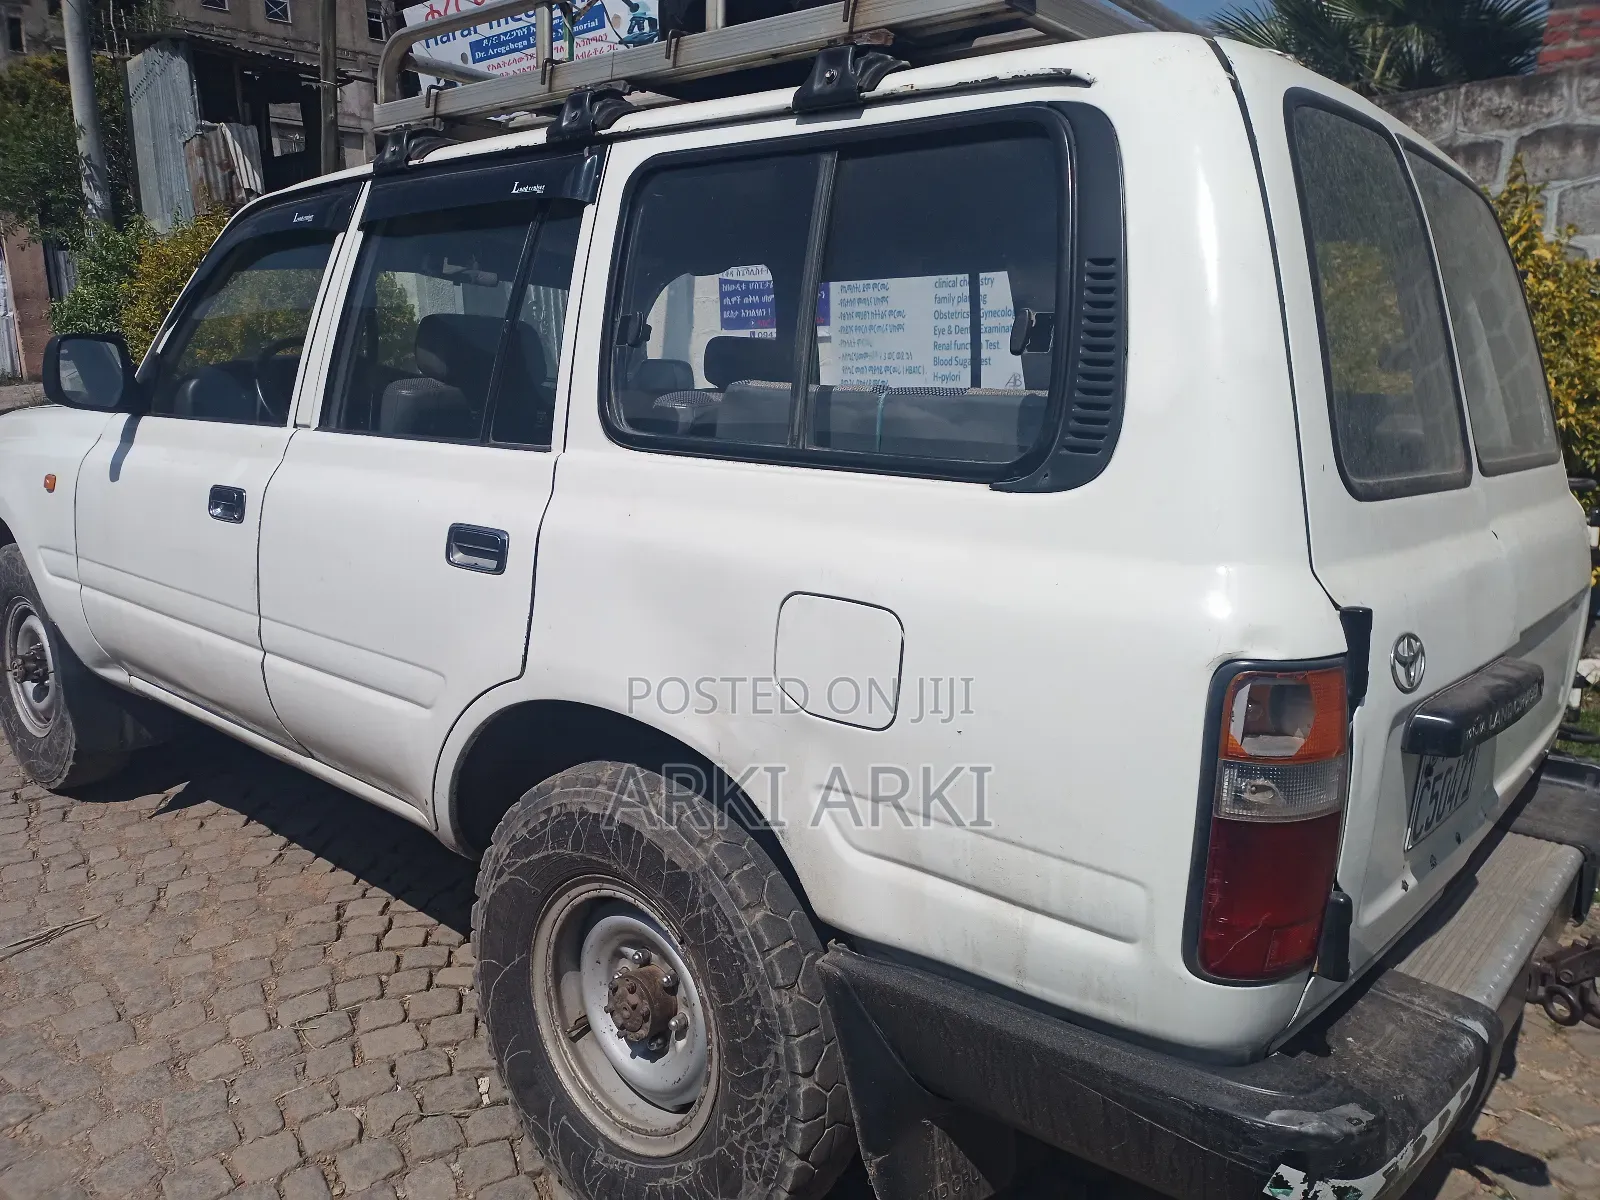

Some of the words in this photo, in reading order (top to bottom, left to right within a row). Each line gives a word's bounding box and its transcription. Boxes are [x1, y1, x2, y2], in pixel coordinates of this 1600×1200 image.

[474, 50, 486, 60] Dr.
[934, 276, 958, 288] clinical
[959, 276, 994, 288] chstry
[934, 292, 956, 307] family
[957, 292, 988, 306] plang
[933, 308, 970, 321] Obstetrics
[933, 325, 946, 338] Eye
[947, 325, 952, 334] &
[980, 322, 1013, 334] Examinat
[933, 340, 952, 351] Renal
[985, 339, 1000, 350] Test
[933, 356, 953, 366] Blood
[954, 356, 971, 369] Suga
[933, 371, 961, 384] H-pylori
